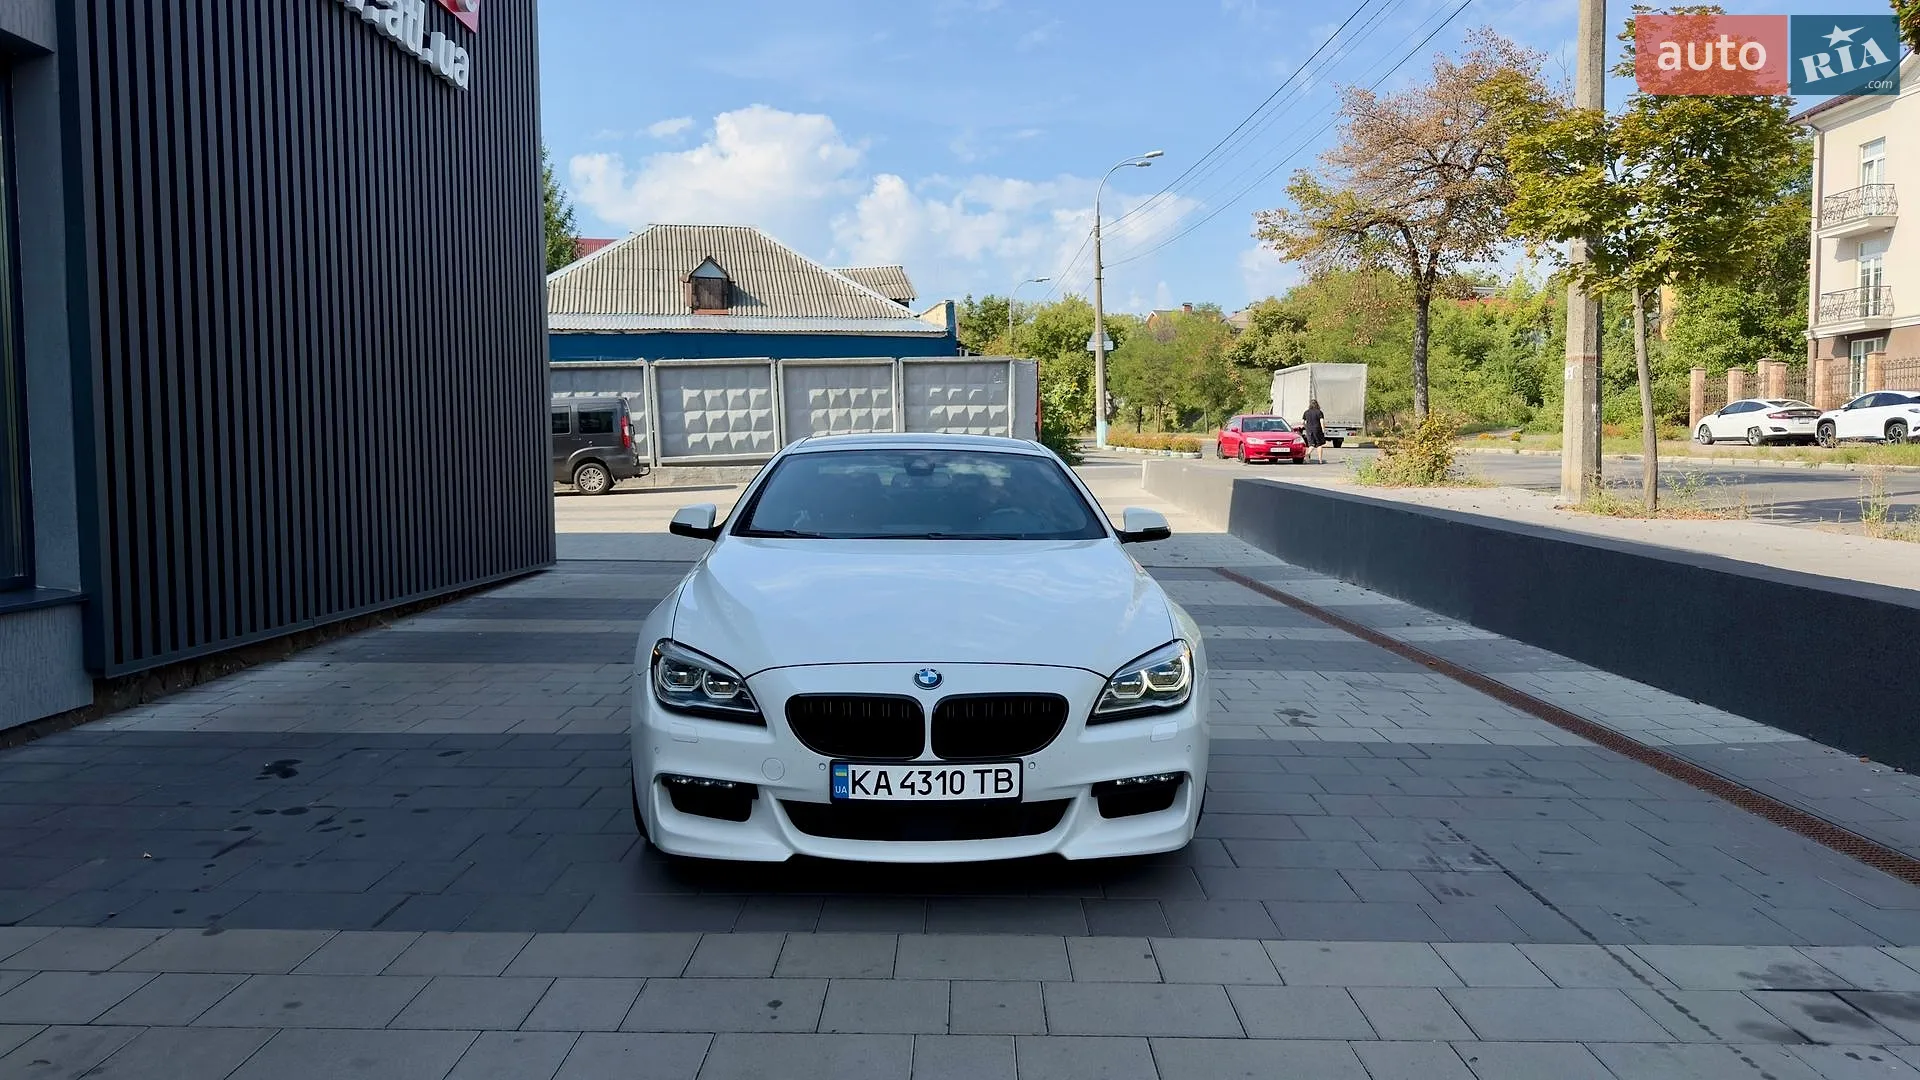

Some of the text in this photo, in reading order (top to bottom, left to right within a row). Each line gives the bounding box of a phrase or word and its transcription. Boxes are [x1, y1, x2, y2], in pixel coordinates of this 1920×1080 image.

[344, 0, 469, 90] .atl.ua
[835, 785, 848, 794] UA
[851, 768, 1014, 796] KA 4310 TB
